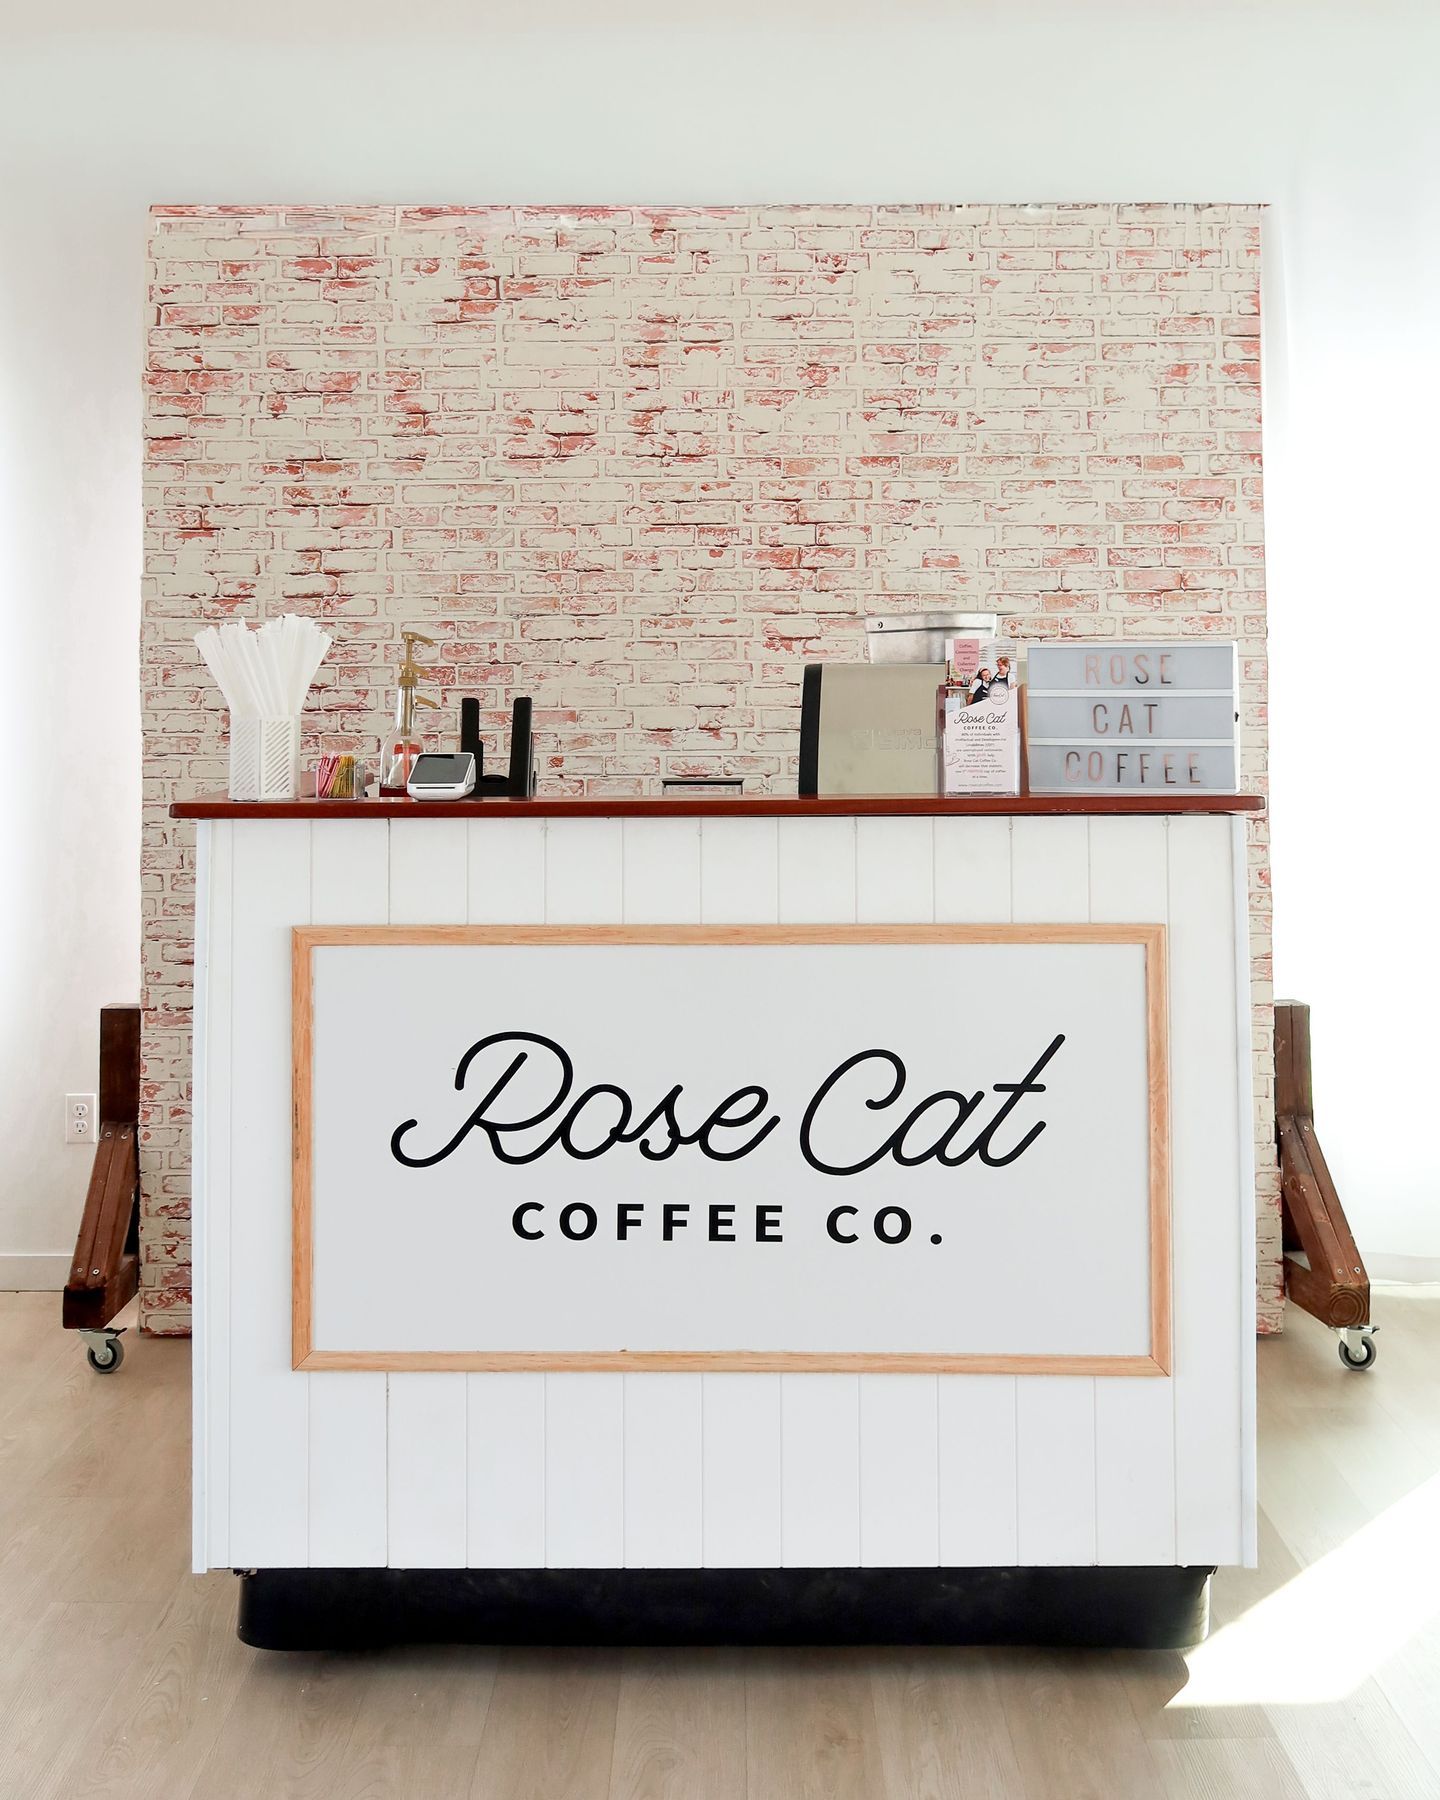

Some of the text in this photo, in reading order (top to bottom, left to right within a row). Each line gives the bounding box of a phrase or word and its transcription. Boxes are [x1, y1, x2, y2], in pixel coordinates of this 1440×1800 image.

[1086, 654, 1173, 685] ROSE
[954, 711, 1008, 724] Rose Cat
[1093, 704, 1158, 735] CAT
[1065, 752, 1201, 784] COFFEE
[391, 1031, 1065, 1175] Rose Cat
[512, 1202, 942, 1244] COFFEE CO.
